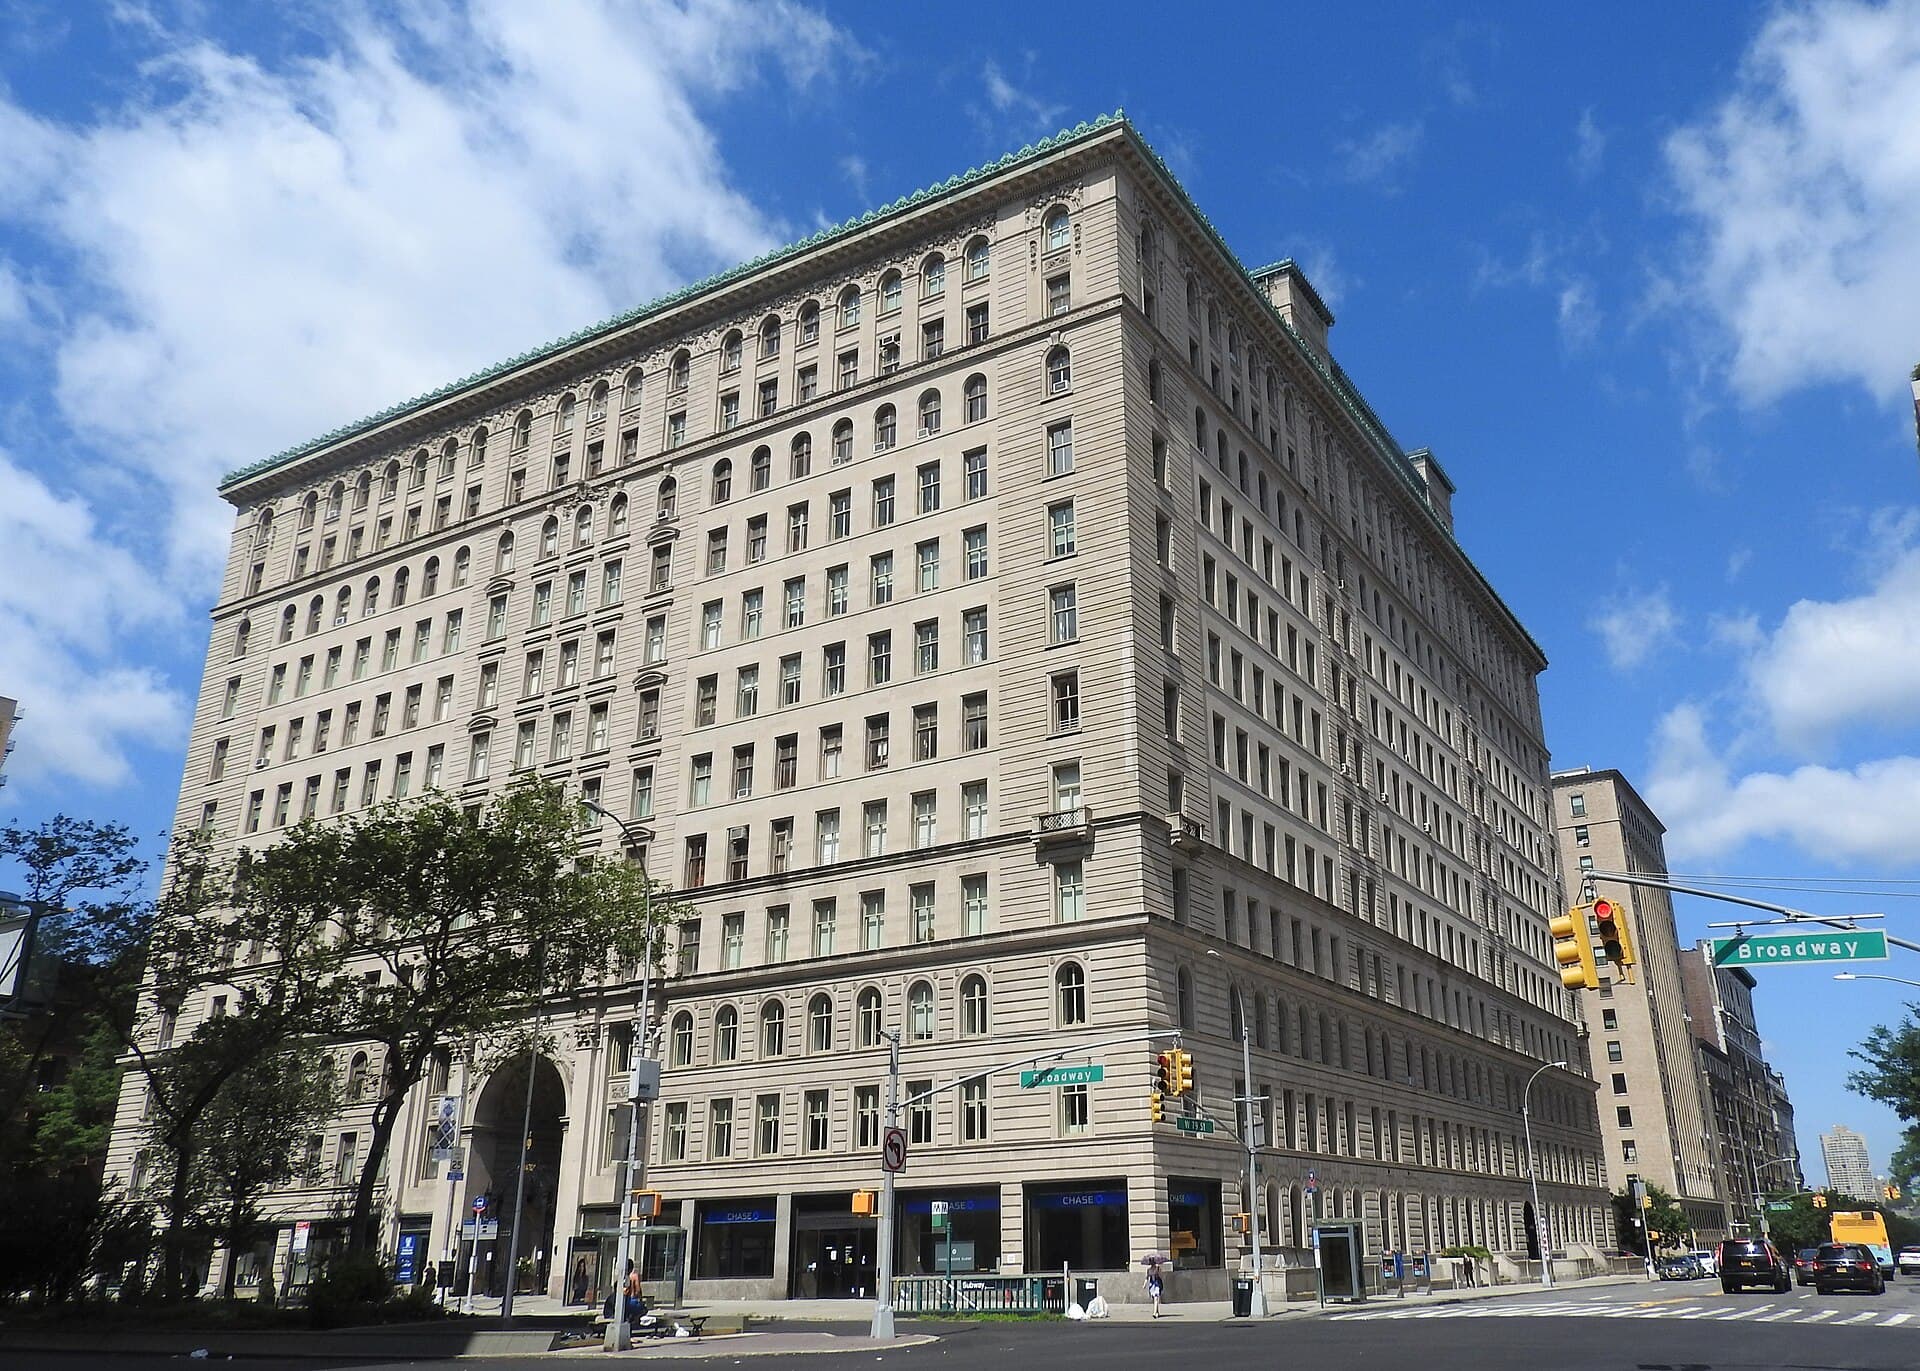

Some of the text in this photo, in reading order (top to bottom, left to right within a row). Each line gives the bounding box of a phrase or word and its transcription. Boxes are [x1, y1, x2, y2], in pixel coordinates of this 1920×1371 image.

[1738, 941, 1858, 959] Broadway
[451, 1160, 463, 1170] 25
[949, 1200, 967, 1210] ASE
[1062, 1195, 1093, 1205] CHASE
[727, 1211, 752, 1221] CHASE
[962, 1280, 985, 1291] Subway
